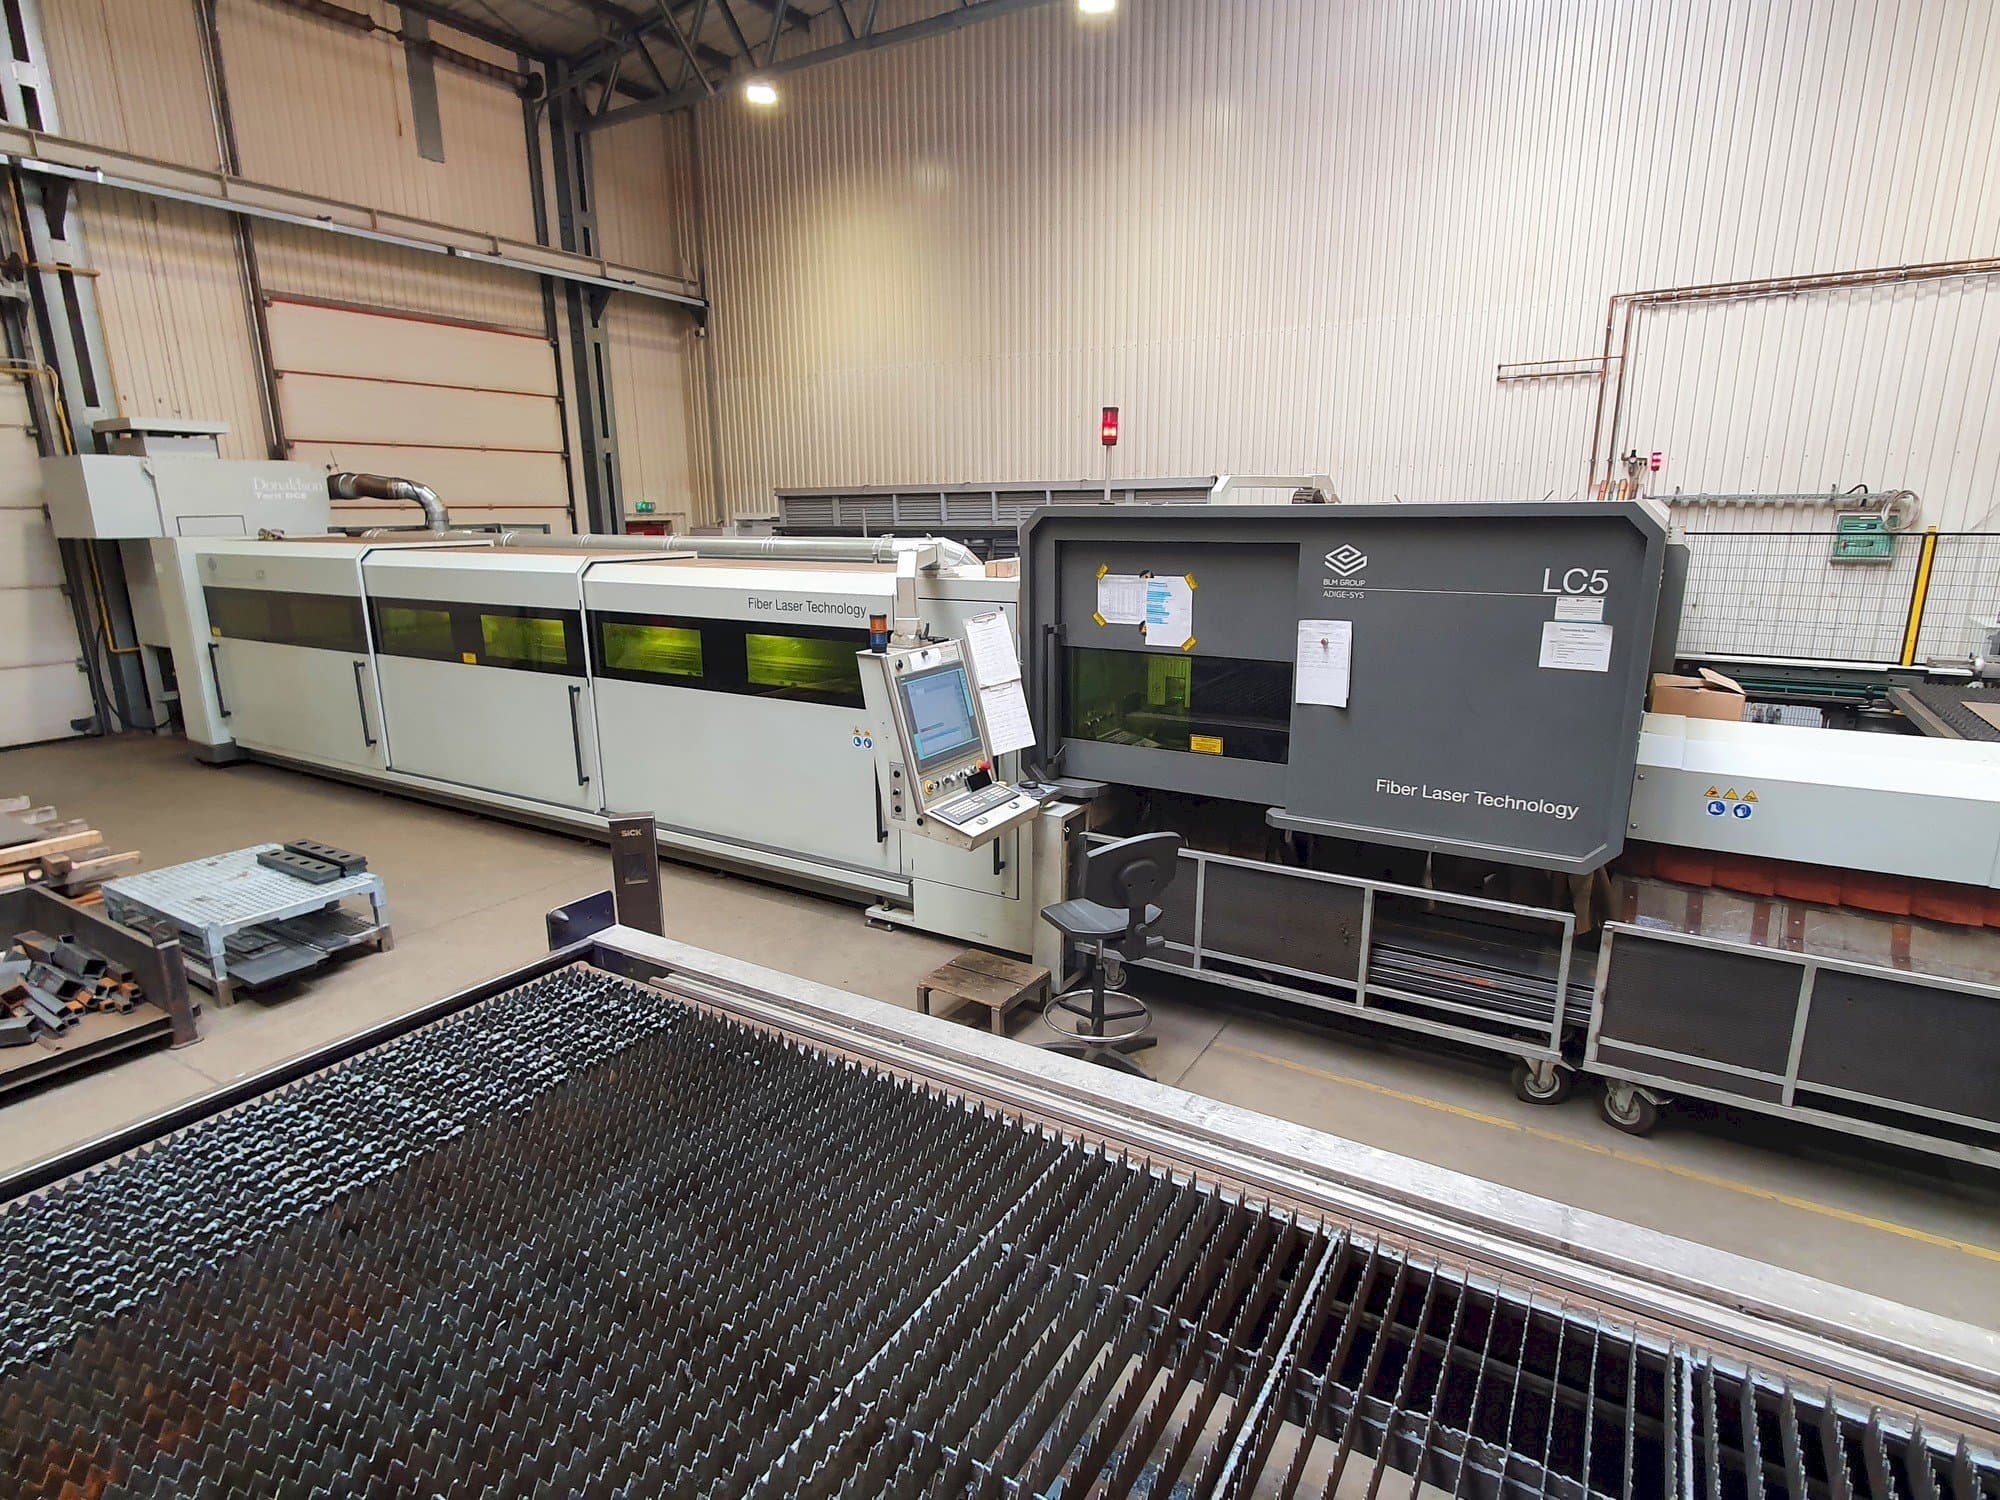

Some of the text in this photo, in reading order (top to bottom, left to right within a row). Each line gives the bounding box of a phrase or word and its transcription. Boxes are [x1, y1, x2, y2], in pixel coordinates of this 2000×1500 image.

[1323, 578, 1367, 587] BLM GROUP
[1542, 567, 1610, 595] LC5
[1322, 590, 1365, 599] ADIGE-SYS
[748, 597, 867, 619] Fiber Laser Technology
[1375, 778, 1580, 821] Fiber Laser Technology
[620, 828, 643, 837] SICK
